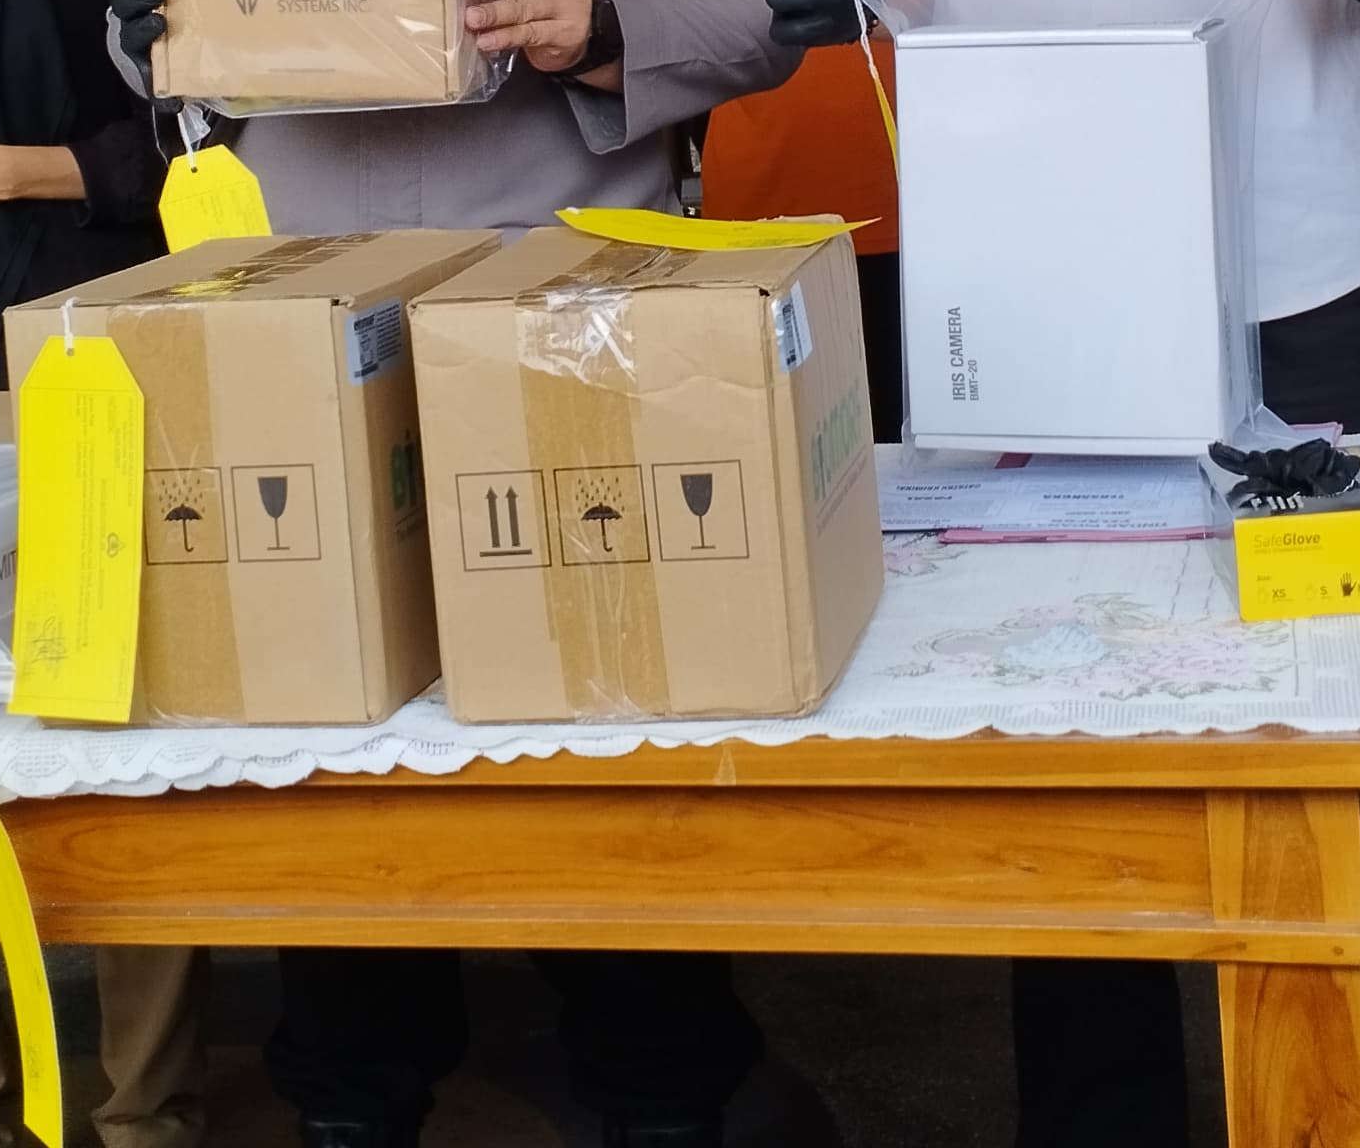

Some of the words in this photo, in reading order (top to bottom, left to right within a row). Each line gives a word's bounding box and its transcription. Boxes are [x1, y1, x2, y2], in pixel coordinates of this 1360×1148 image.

[277, 0, 340, 13] SYSTEMS
[947, 306, 964, 367] CAMERA
[951, 373, 966, 401] IRIS
[967, 359, 980, 401] BMT-20
[1253, 532, 1321, 548] SafeGlove
[1272, 588, 1287, 598] XS
[1319, 586, 1329, 596] S
